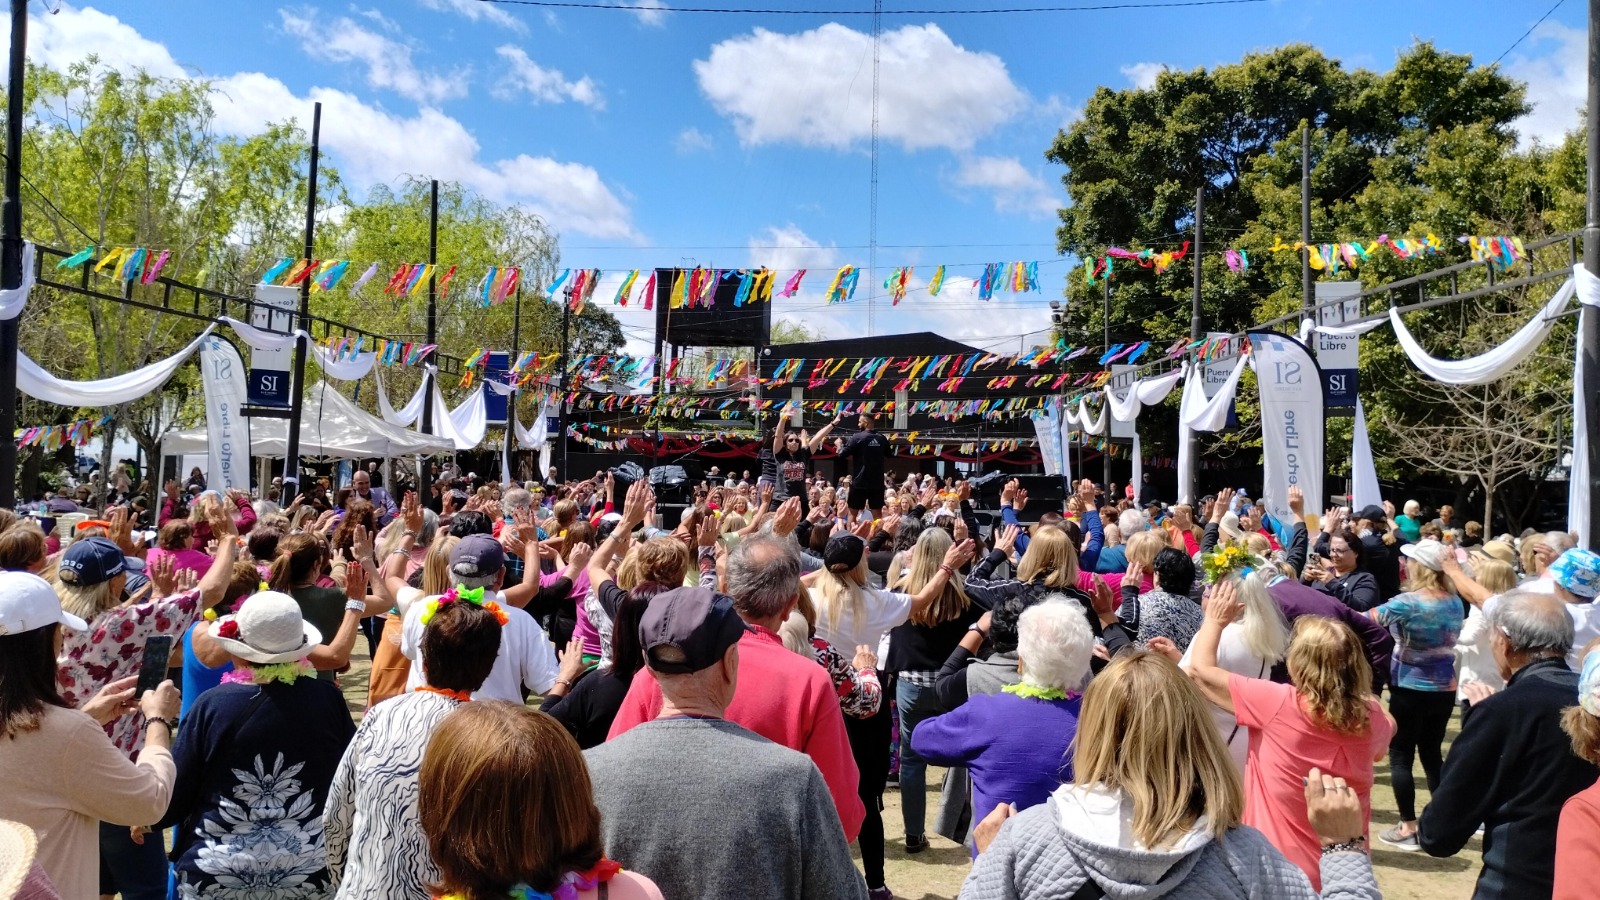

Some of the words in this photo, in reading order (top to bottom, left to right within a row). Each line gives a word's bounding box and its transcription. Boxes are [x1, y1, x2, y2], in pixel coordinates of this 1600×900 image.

[1320, 341, 1347, 350] Libre
[261, 375, 278, 391] SI
[1329, 374, 1346, 390] SI
